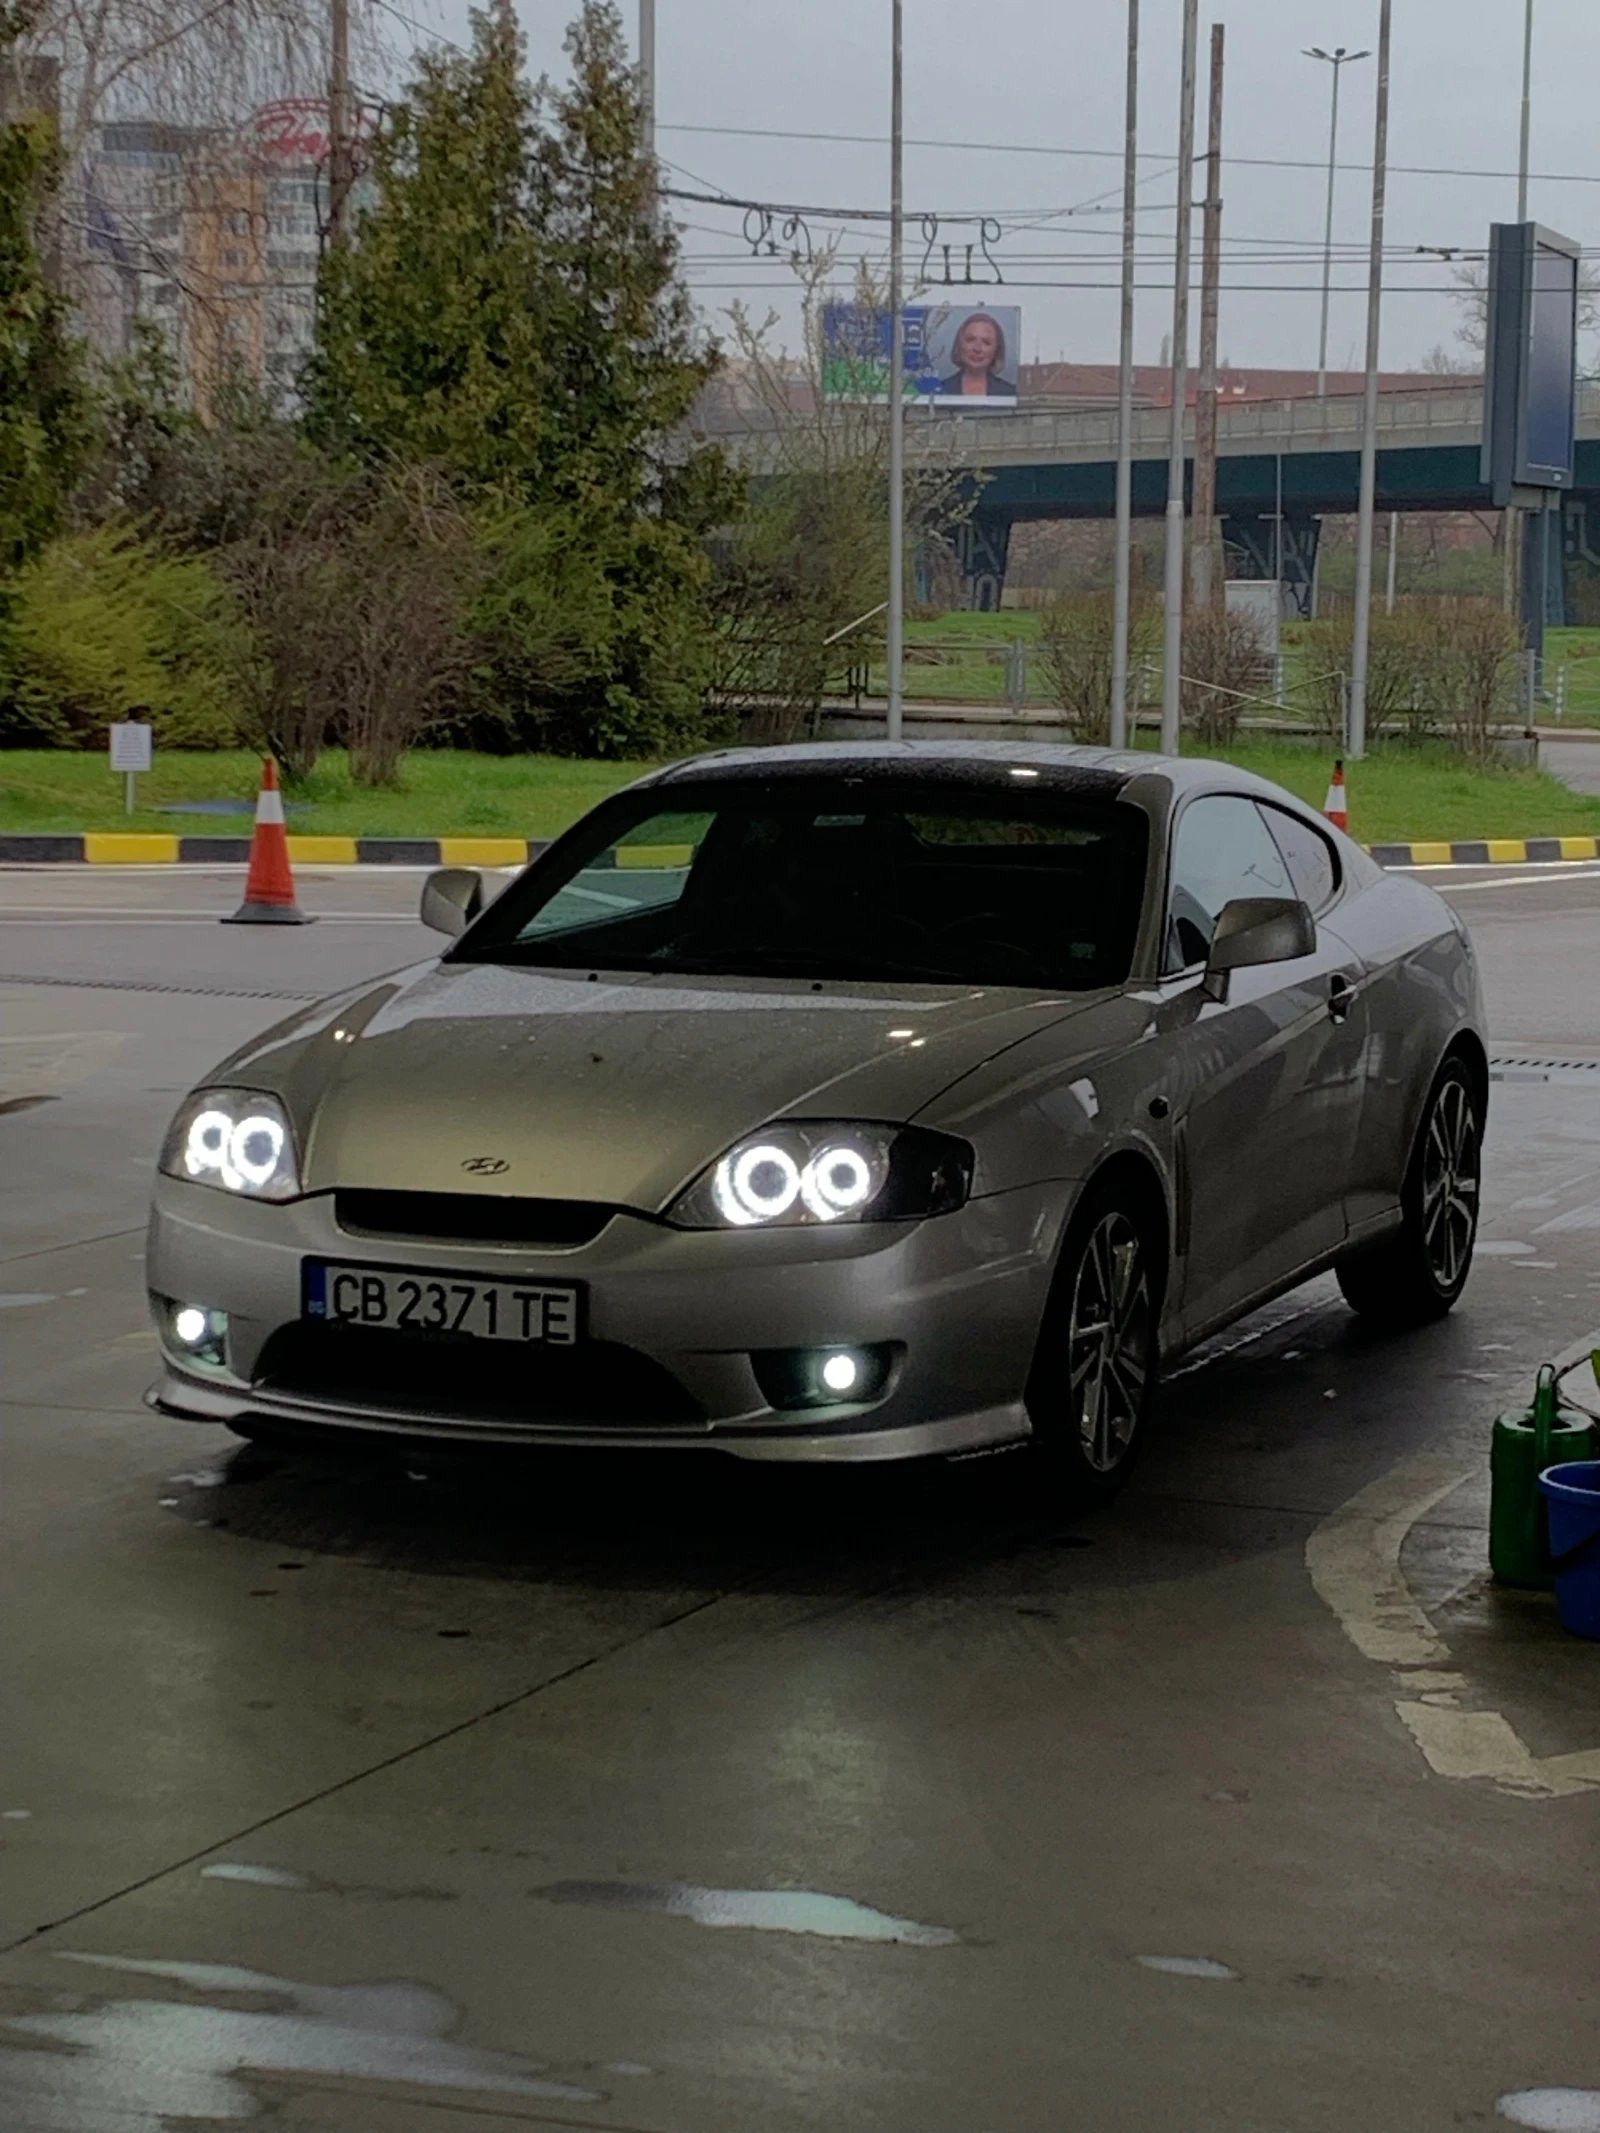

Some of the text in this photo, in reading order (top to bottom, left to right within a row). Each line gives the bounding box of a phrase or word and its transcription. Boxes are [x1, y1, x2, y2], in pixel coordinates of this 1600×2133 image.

[333, 1274, 570, 1340] CB 2371 TE
